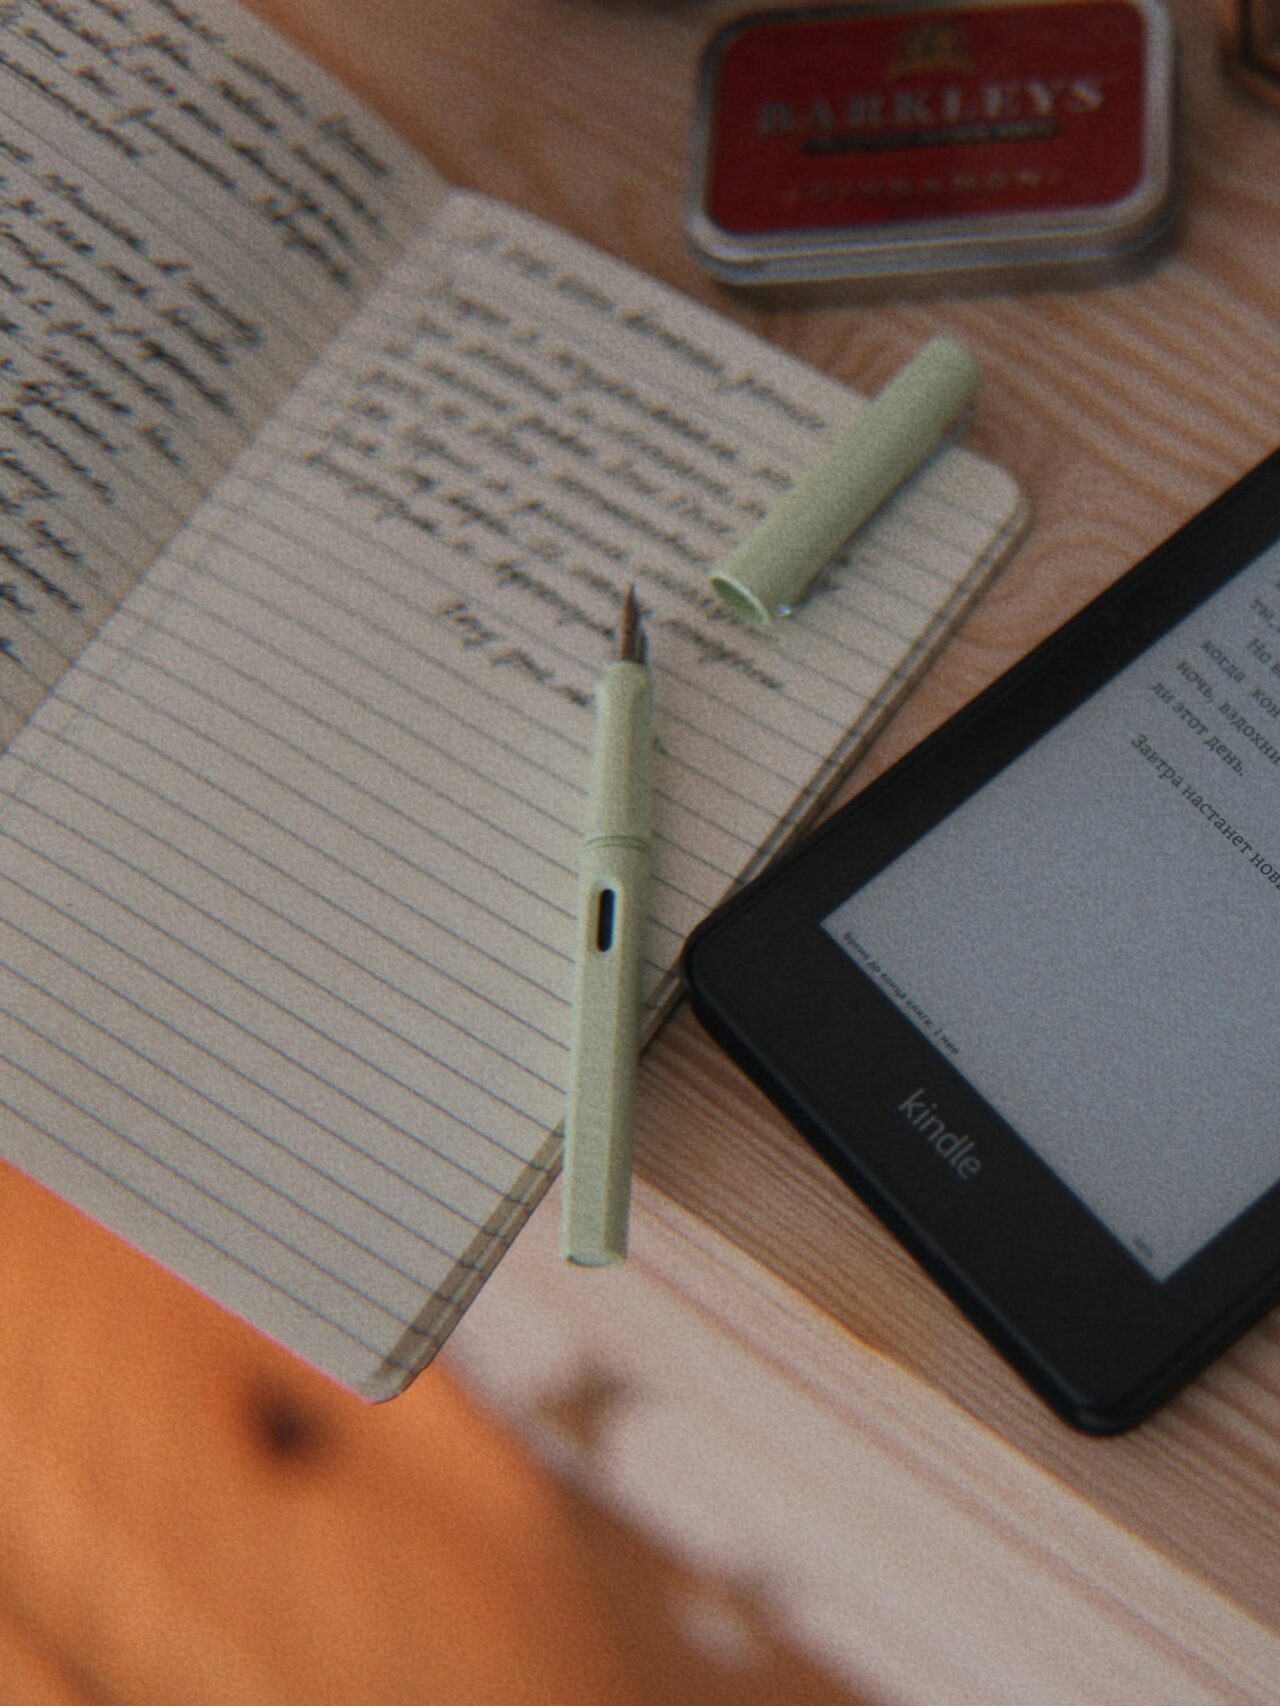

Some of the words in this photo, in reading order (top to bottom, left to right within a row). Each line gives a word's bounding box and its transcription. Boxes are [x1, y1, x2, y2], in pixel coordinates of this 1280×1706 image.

[757, 79, 1103, 139] BARKLEYS
[1200, 639, 1246, 683] когда
[1244, 635, 1273, 665] Но
[1175, 660, 1213, 704] ночь,
[1147, 680, 1176, 705] ли
[1171, 701, 1209, 736] этот
[1201, 735, 1243, 777] день.
[1129, 732, 1184, 789] Завтра
[1180, 783, 1253, 854] настанет
[899, 1088, 981, 1180] kindle
